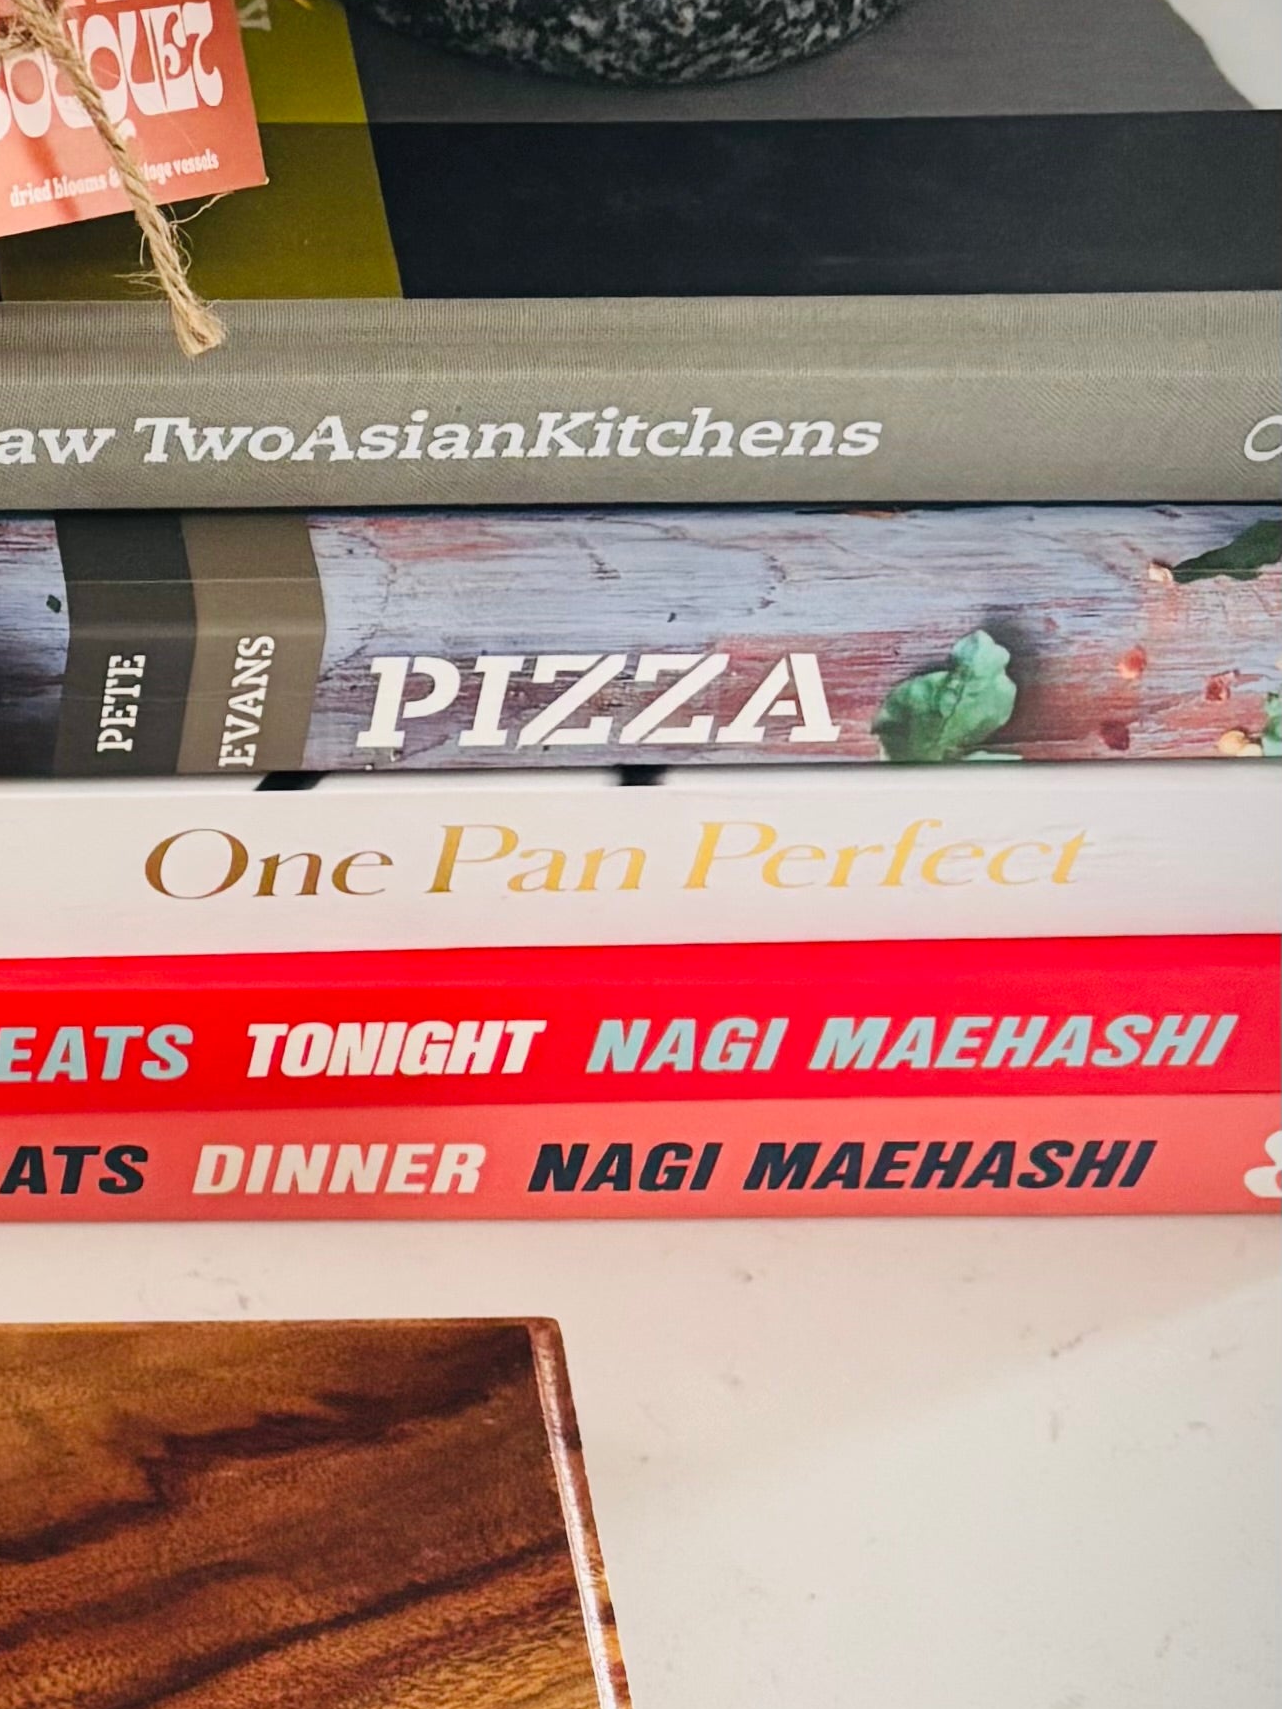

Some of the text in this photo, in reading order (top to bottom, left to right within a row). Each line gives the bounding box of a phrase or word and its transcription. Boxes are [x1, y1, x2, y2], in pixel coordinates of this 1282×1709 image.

[9, 178, 53, 208] dried
[53, 172, 108, 201] blooms
[172, 147, 220, 177] vessels
[133, 405, 884, 464] TwoAsianKitchens
[96, 653, 146, 753] PETE
[218, 634, 276, 769] EVANS
[354, 651, 840, 750] PIZZA
[144, 818, 1090, 900] One Pan Perfect
[245, 1018, 547, 1079] TONIGHT
[585, 1016, 789, 1074] NAGI
[807, 1013, 1239, 1073] MAEHASHI
[191, 1142, 488, 1195] DINNER
[526, 1140, 724, 1194] NAGI
[742, 1138, 1158, 1192] MAEHASHI
